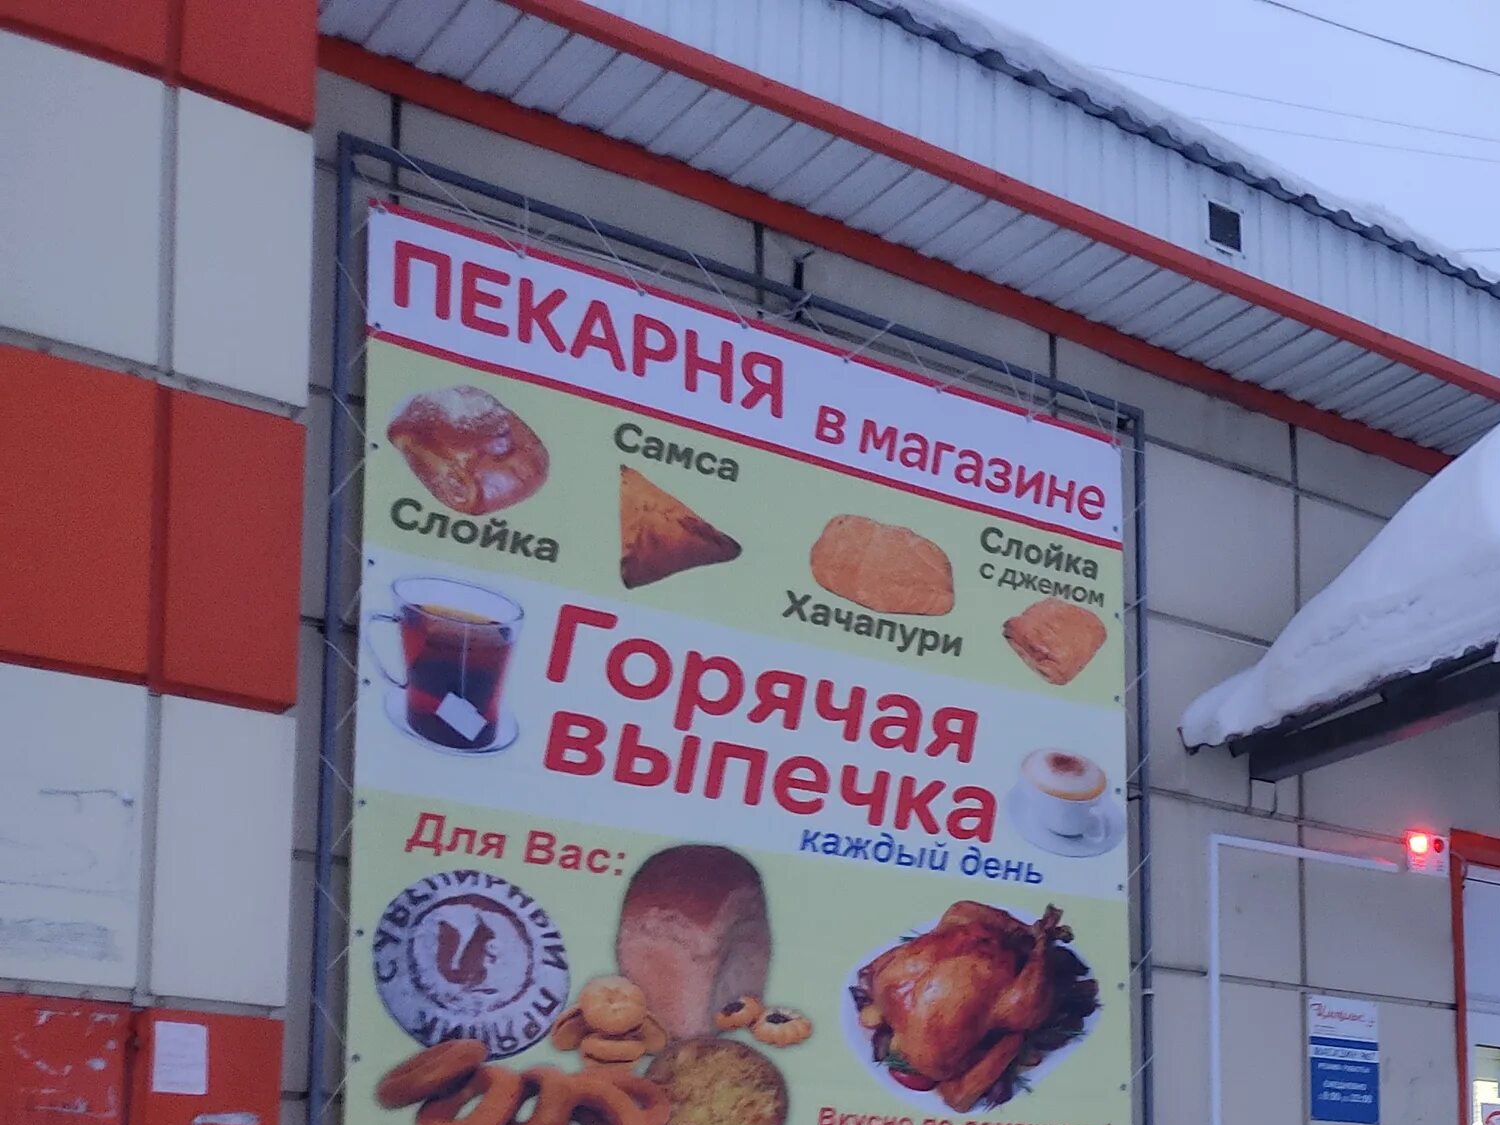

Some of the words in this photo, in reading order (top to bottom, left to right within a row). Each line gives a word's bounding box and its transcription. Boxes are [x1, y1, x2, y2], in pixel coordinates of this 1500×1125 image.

[392, 240, 785, 419] ПЕКАРНЯ
[814, 402, 847, 446] в
[858, 415, 1107, 521] магазине
[612, 421, 741, 483] Самса
[388, 496, 561, 565] Слойка
[978, 526, 1100, 581] Слойка
[979, 561, 996, 581] с
[998, 566, 1106, 609] джемом
[781, 590, 964, 659] Хачапури
[544, 602, 979, 765] Горячая
[543, 709, 999, 844] выпечка
[404, 812, 507, 863] Для
[522, 828, 628, 877] Вас:
[800, 826, 949, 873] каждый
[959, 846, 1044, 886] день
